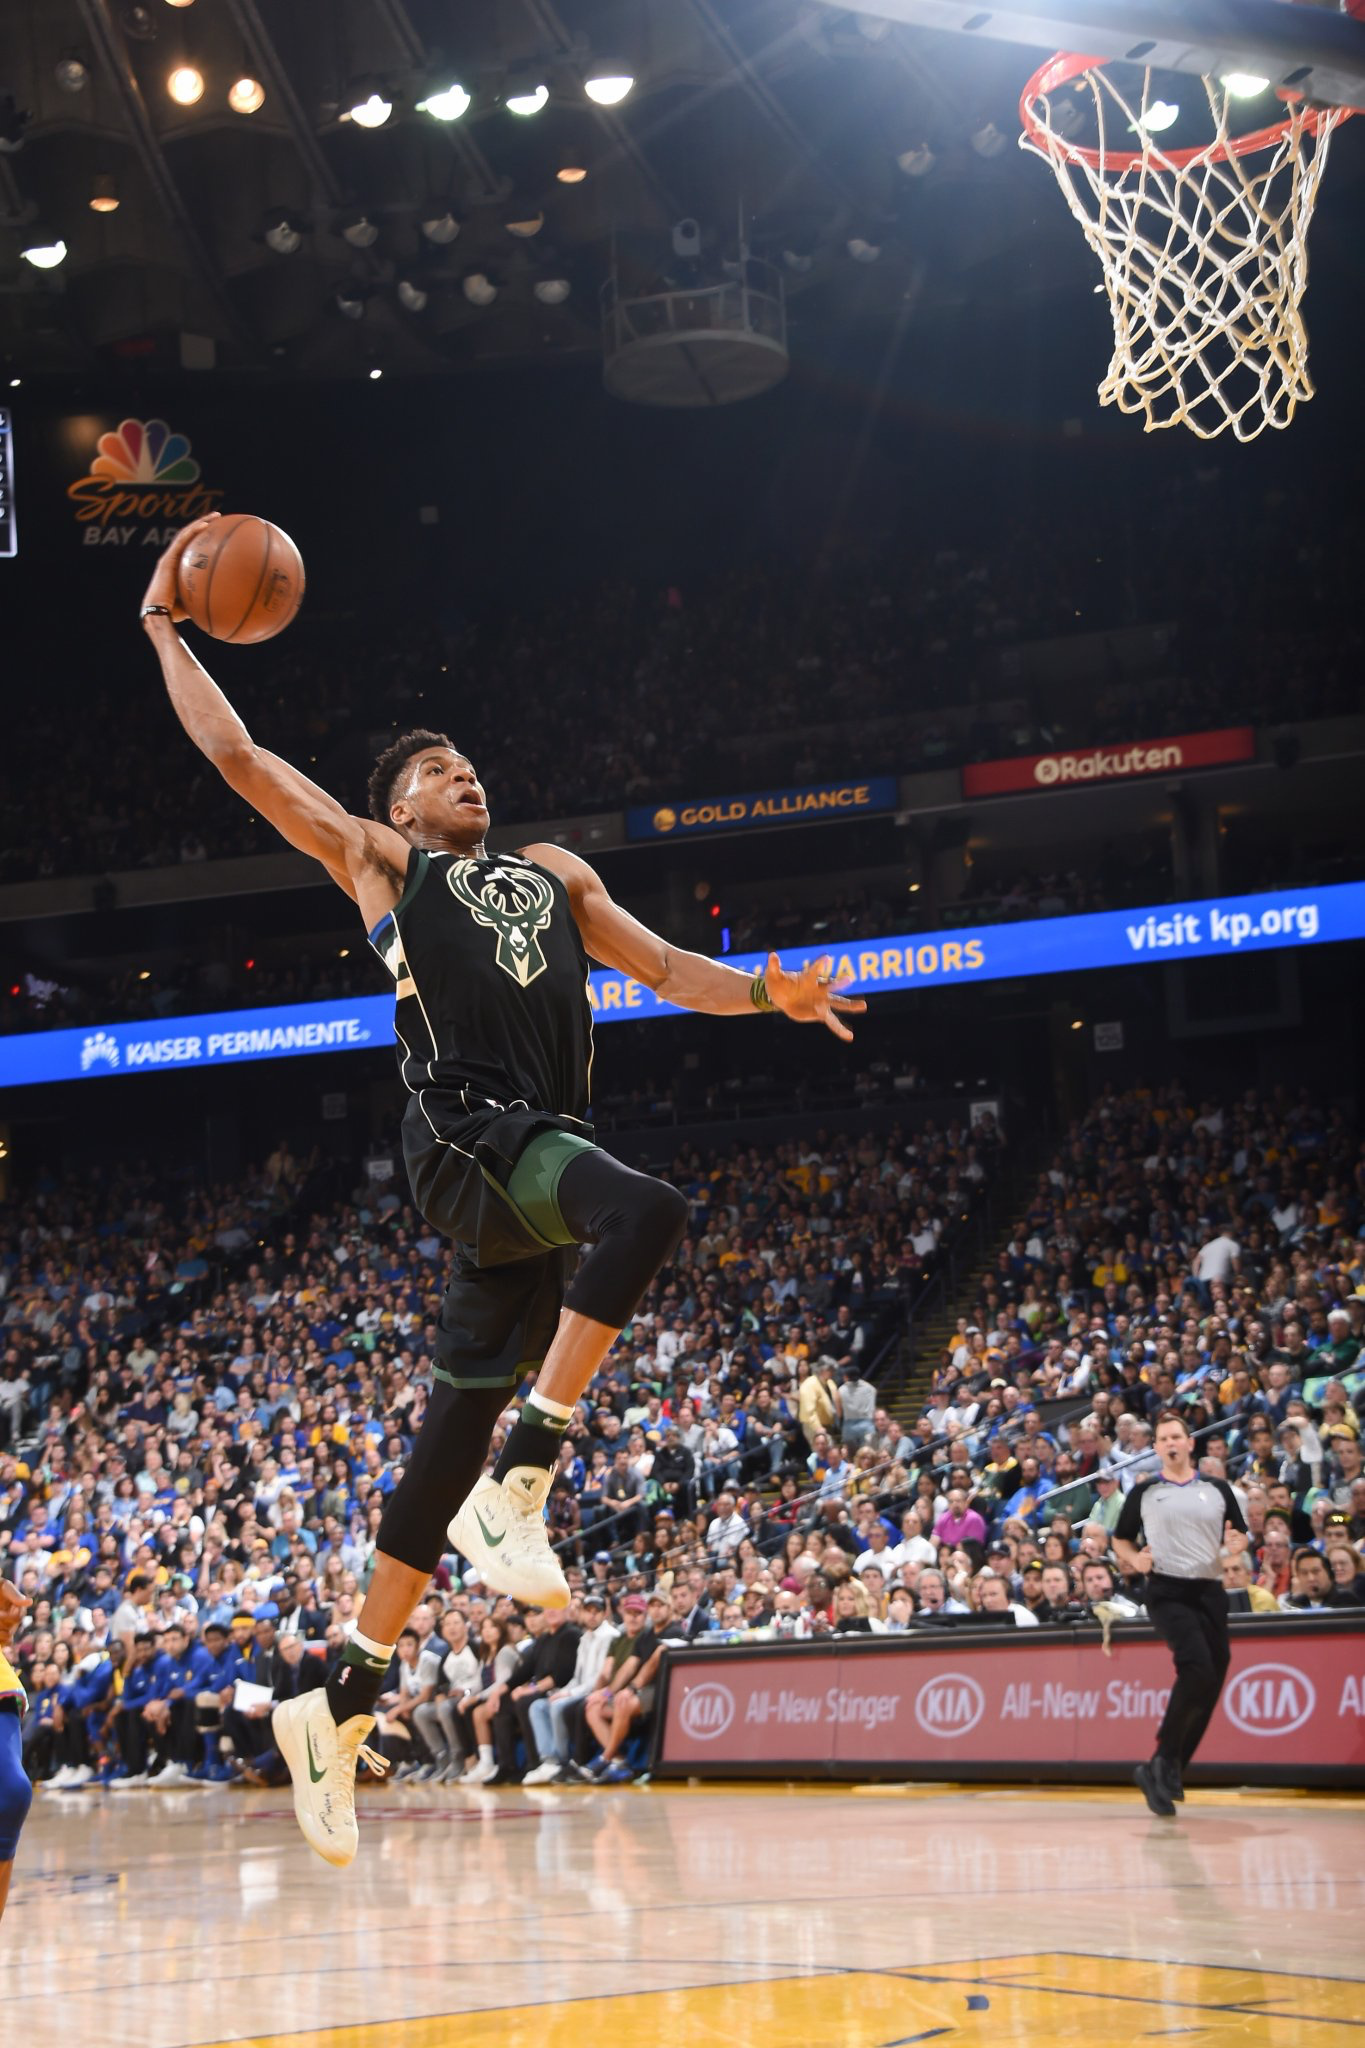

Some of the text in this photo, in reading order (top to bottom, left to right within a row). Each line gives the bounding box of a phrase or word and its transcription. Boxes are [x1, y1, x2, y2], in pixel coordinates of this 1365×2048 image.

[67, 474, 225, 526] Sports
[83, 526, 180, 545] BAY AR
[1060, 745, 1183, 781] Rakuten
[680, 786, 870, 825] GOLD ALLIANCE
[1126, 904, 1319, 950] visit kp.org
[126, 1036, 202, 1066] KAISER
[688, 1694, 724, 1725] KIA
[745, 1687, 900, 1730] All-New Stinger
[926, 1686, 973, 1722] KIA
[1000, 1679, 1172, 1727] All-New Sting
[1239, 1679, 1299, 1719] KIA
